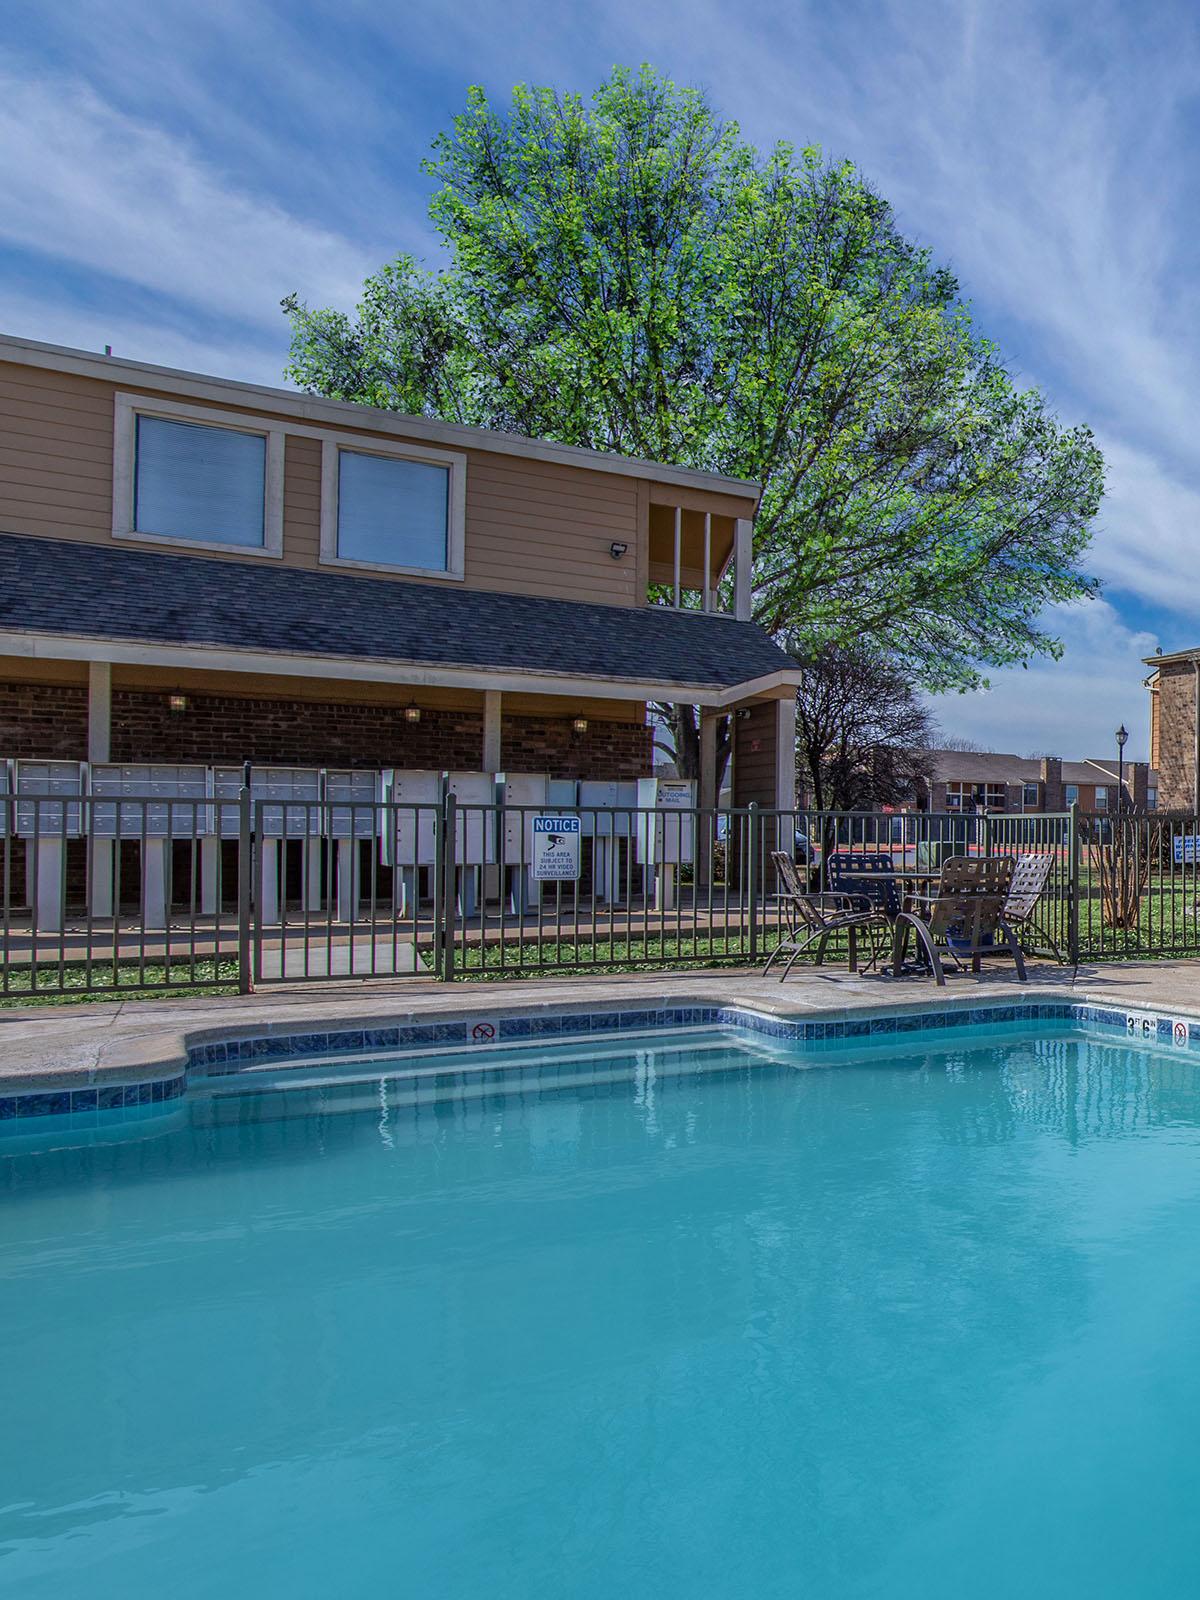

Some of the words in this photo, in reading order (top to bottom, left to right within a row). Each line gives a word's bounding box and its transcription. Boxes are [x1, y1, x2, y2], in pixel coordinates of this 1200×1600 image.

[536, 819, 578, 831] NOTICE
[1128, 1017, 1134, 1029] 3
[1143, 1020, 1149, 1031] 6
